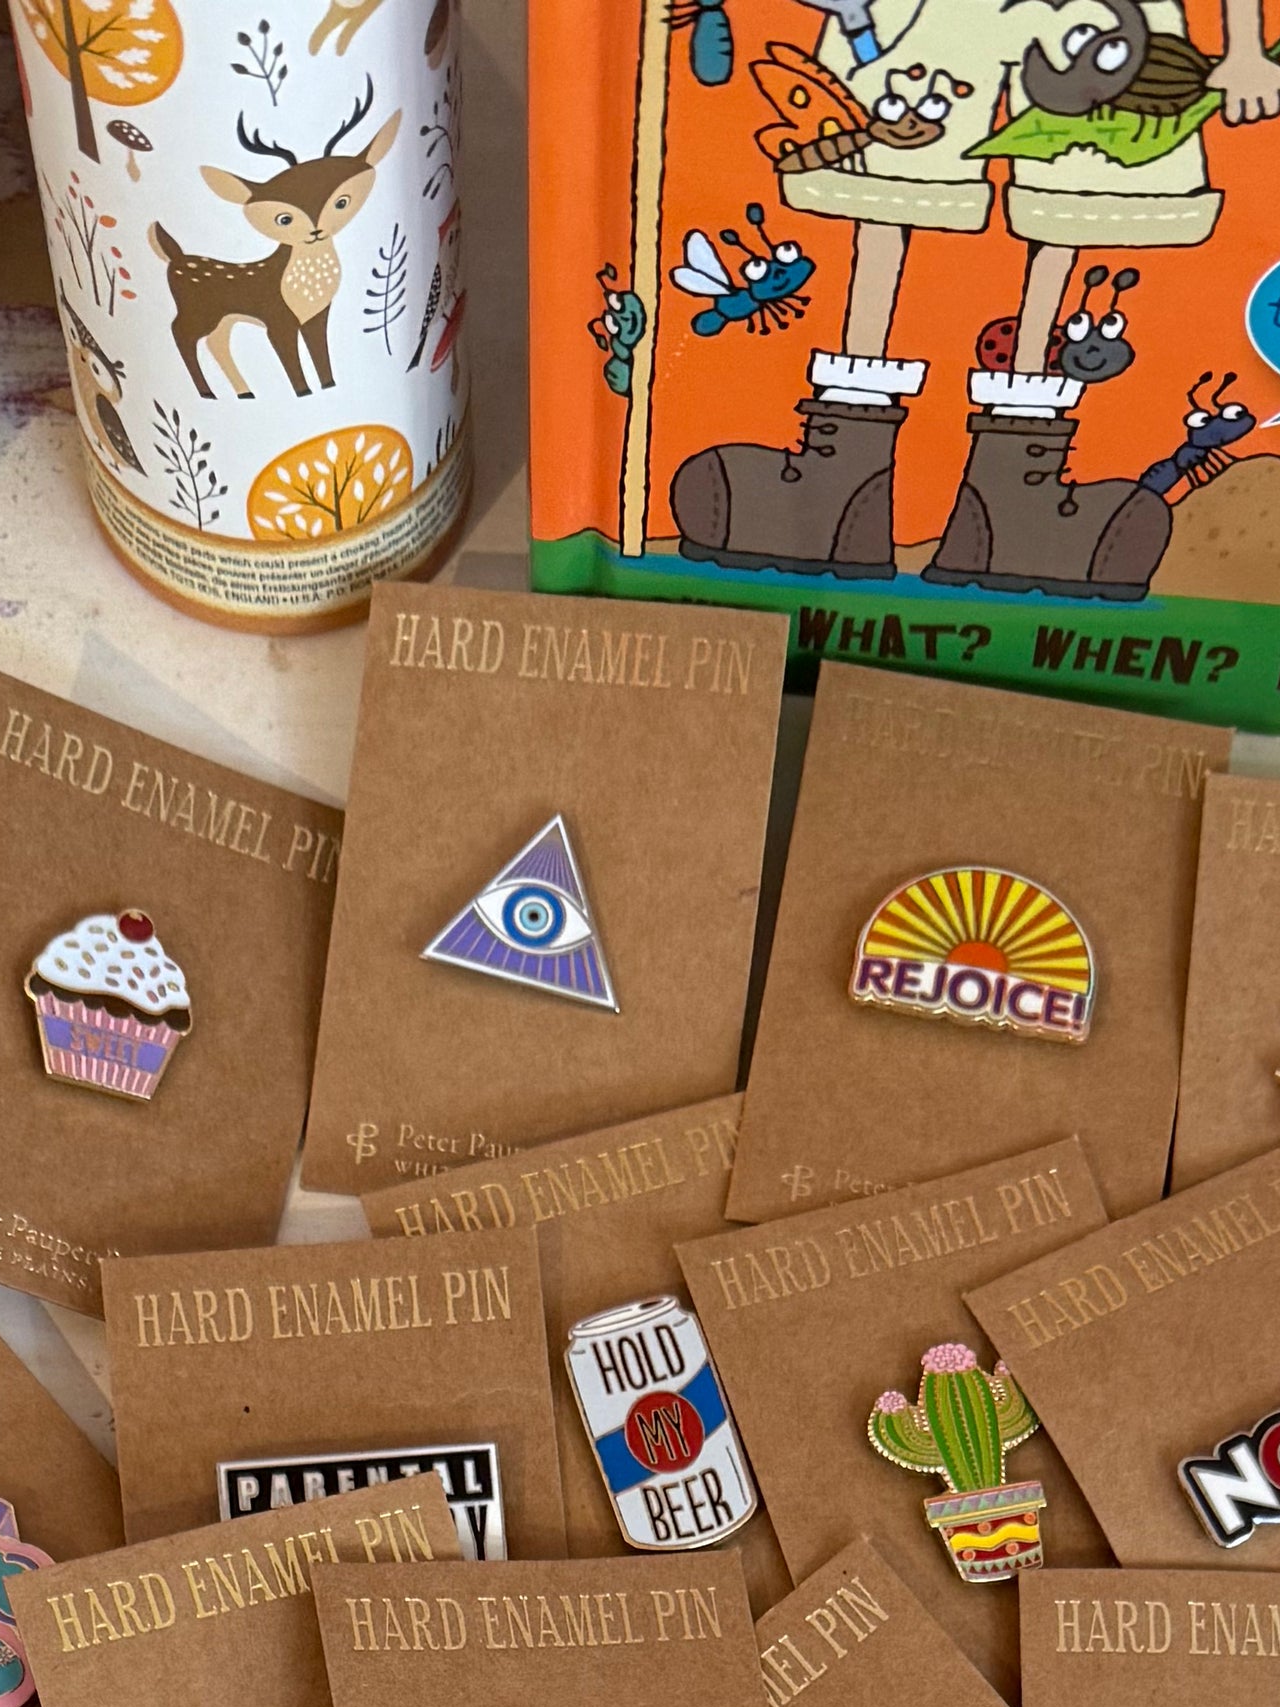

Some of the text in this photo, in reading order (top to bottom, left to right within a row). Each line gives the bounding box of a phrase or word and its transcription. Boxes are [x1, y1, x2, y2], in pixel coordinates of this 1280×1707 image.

[389, 613, 756, 695] HARD ENAMEL PIN
[797, 608, 992, 662] WHAT?
[1032, 628, 1240, 684] WHEN?
[855, 957, 1086, 1030] REJOICE!
[711, 1168, 1074, 1311] HARD ENAMEL PIN
[134, 1266, 512, 1348] HARD ENAMEL PIN
[591, 1325, 687, 1395] HOLD
[636, 1405, 691, 1465] MY
[642, 1468, 734, 1544] BEER
[346, 1585, 723, 1652] HARD ENAMEL PIN
[1055, 1599, 1172, 1653] HARD
